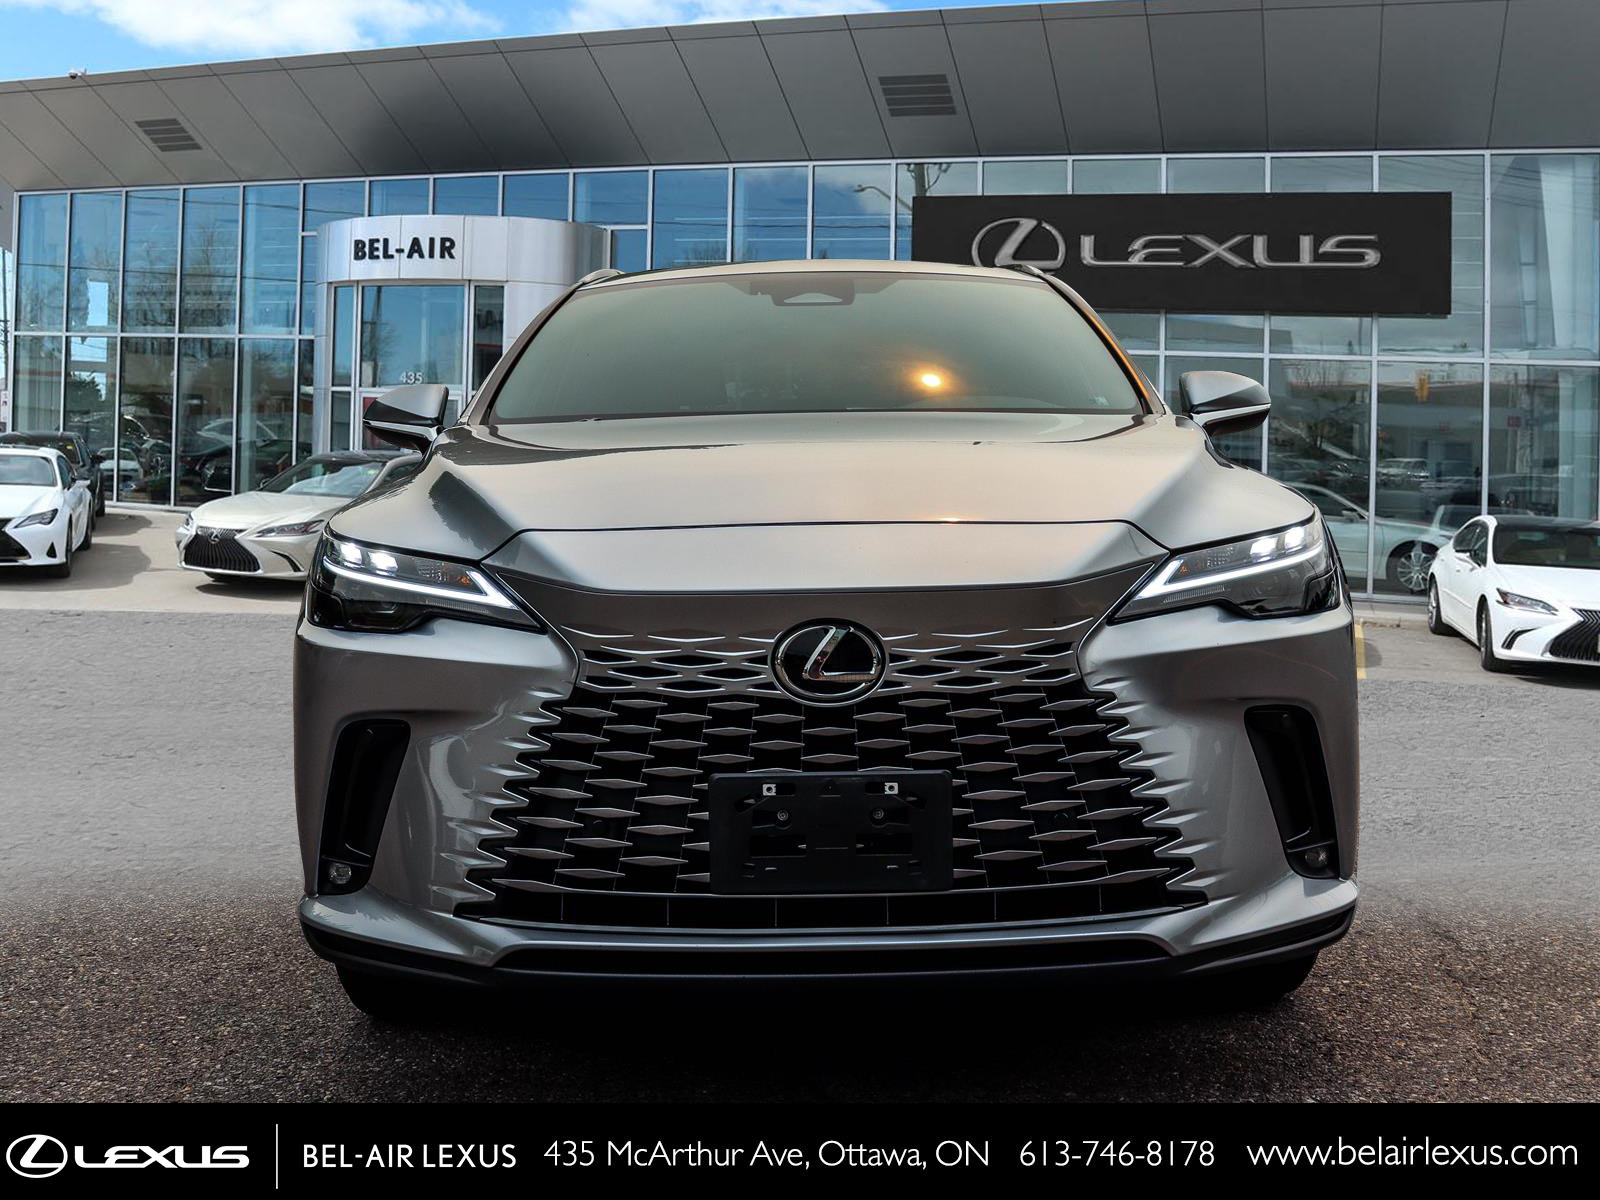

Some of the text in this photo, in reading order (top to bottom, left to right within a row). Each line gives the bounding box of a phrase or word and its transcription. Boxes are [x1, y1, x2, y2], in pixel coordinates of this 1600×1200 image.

[353, 236, 456, 261] BEL-AIR
[1080, 233, 1382, 269] LEXUS
[400, 371, 423, 385] 435
